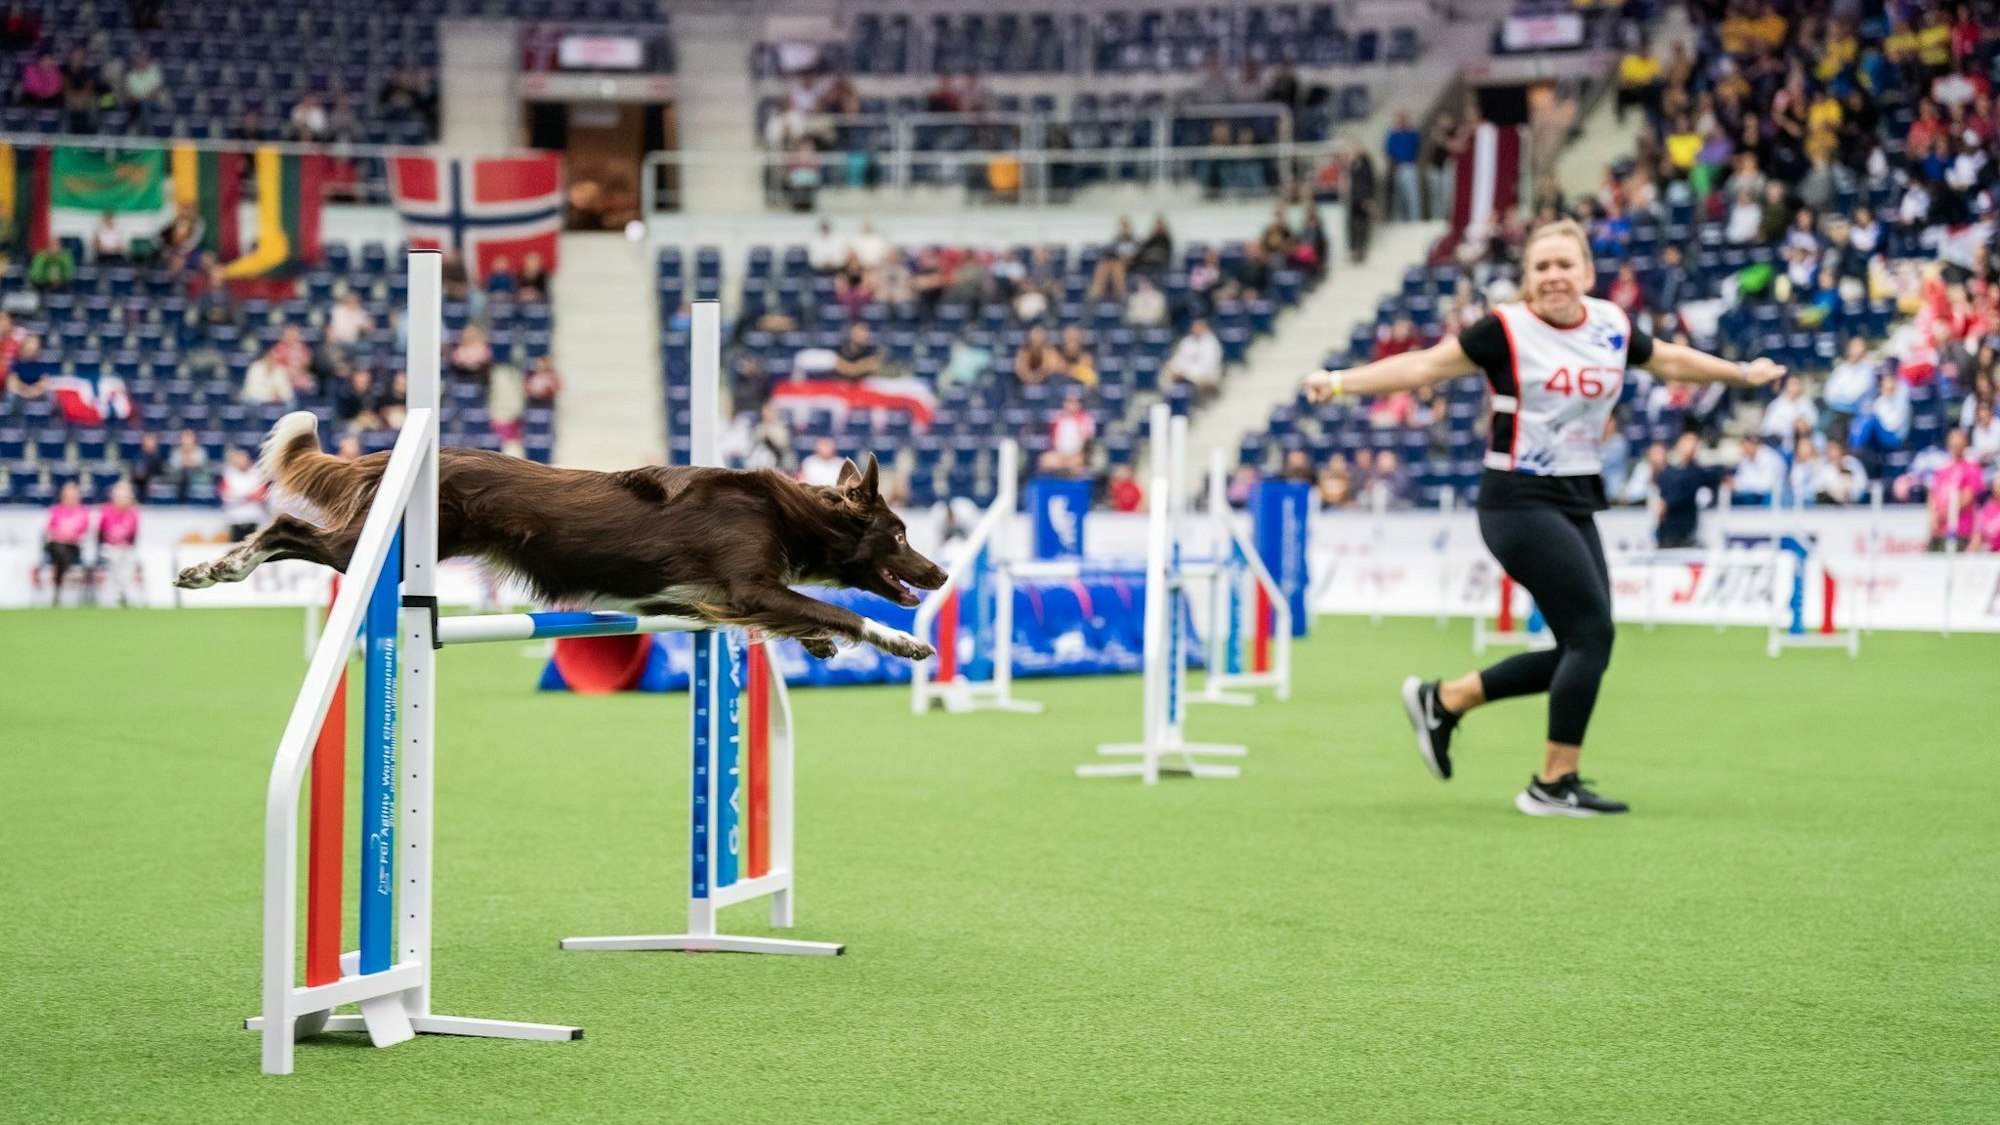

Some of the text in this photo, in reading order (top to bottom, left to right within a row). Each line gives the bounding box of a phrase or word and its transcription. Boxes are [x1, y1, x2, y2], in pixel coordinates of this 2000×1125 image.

[1544, 367, 1622, 399] 467
[383, 638, 393, 741] Championship
[382, 744, 391, 786] World
[380, 792, 391, 837] Agility
